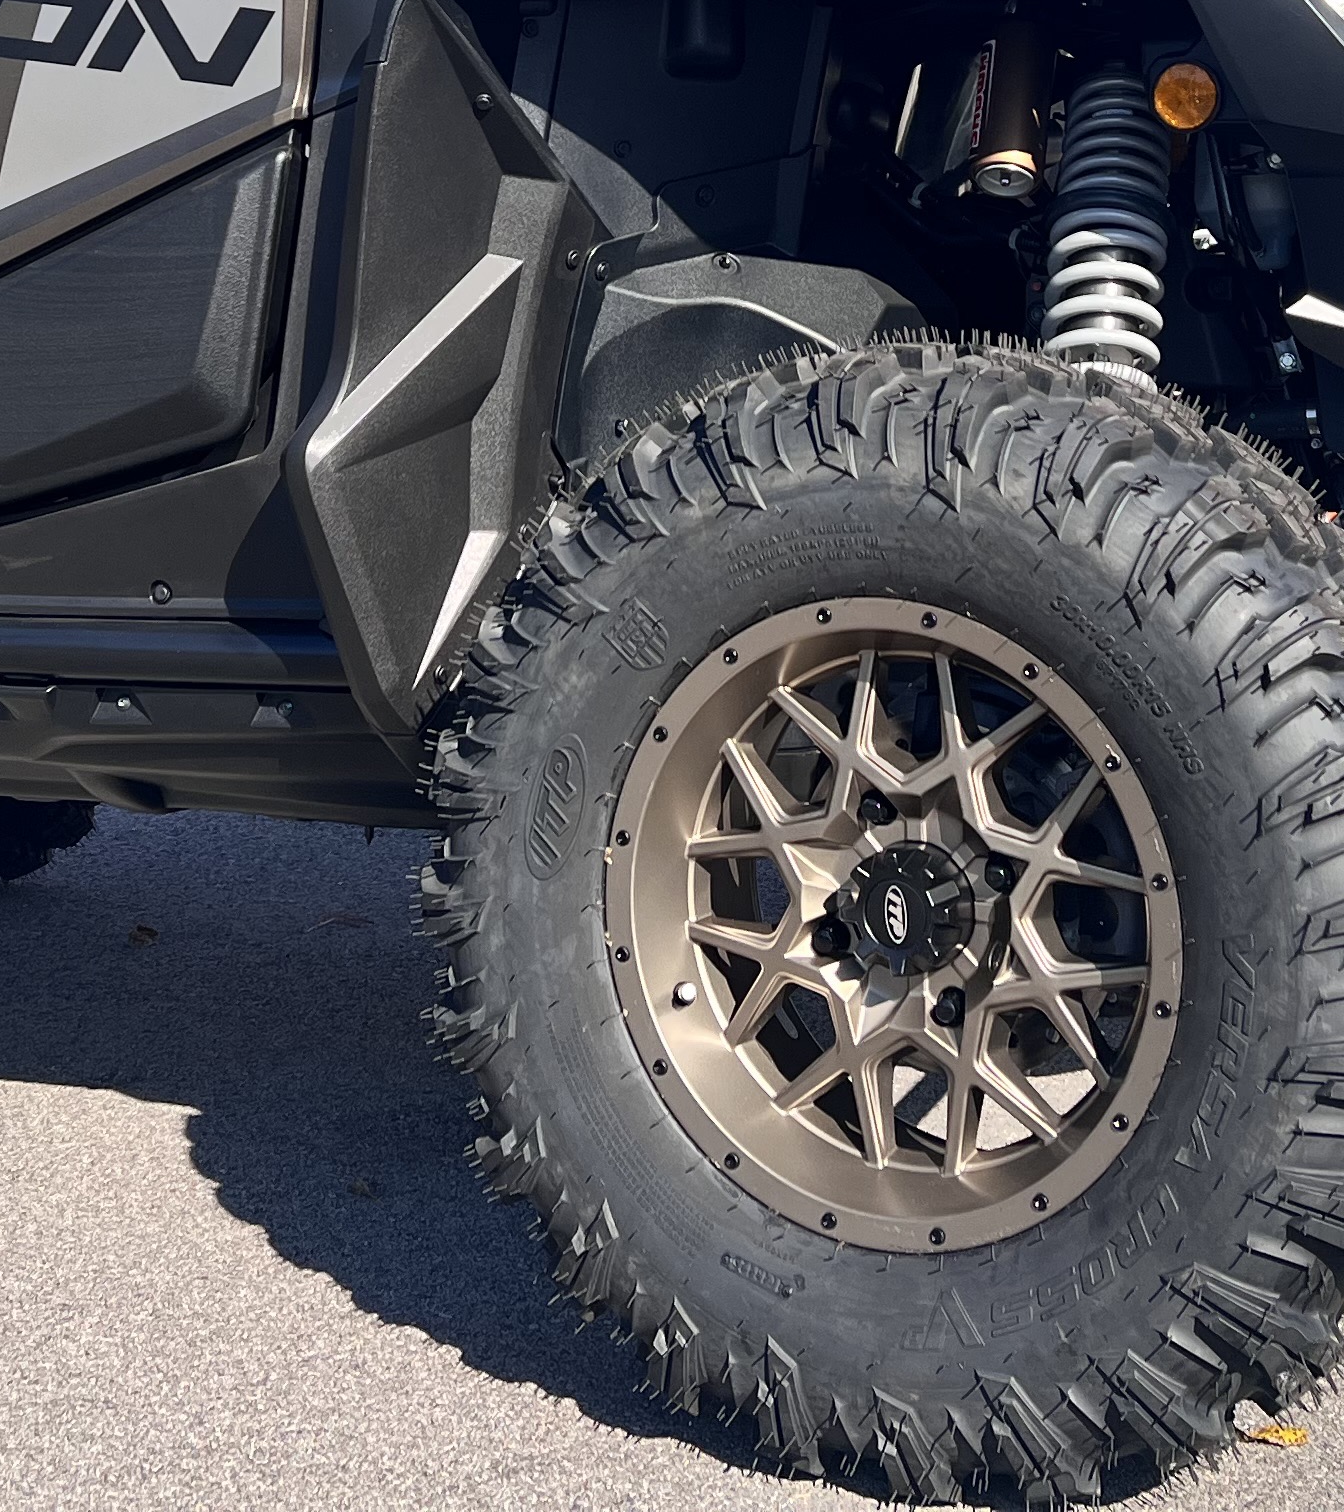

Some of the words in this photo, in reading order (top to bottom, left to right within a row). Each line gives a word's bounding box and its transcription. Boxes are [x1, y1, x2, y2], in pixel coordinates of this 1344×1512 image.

[527, 745, 576, 868] ITP
[1163, 721, 1205, 776] NHS
[887, 890, 905, 939] ITP
[1173, 933, 1256, 1173] VERSA
[990, 1183, 1180, 1339] CROSS
